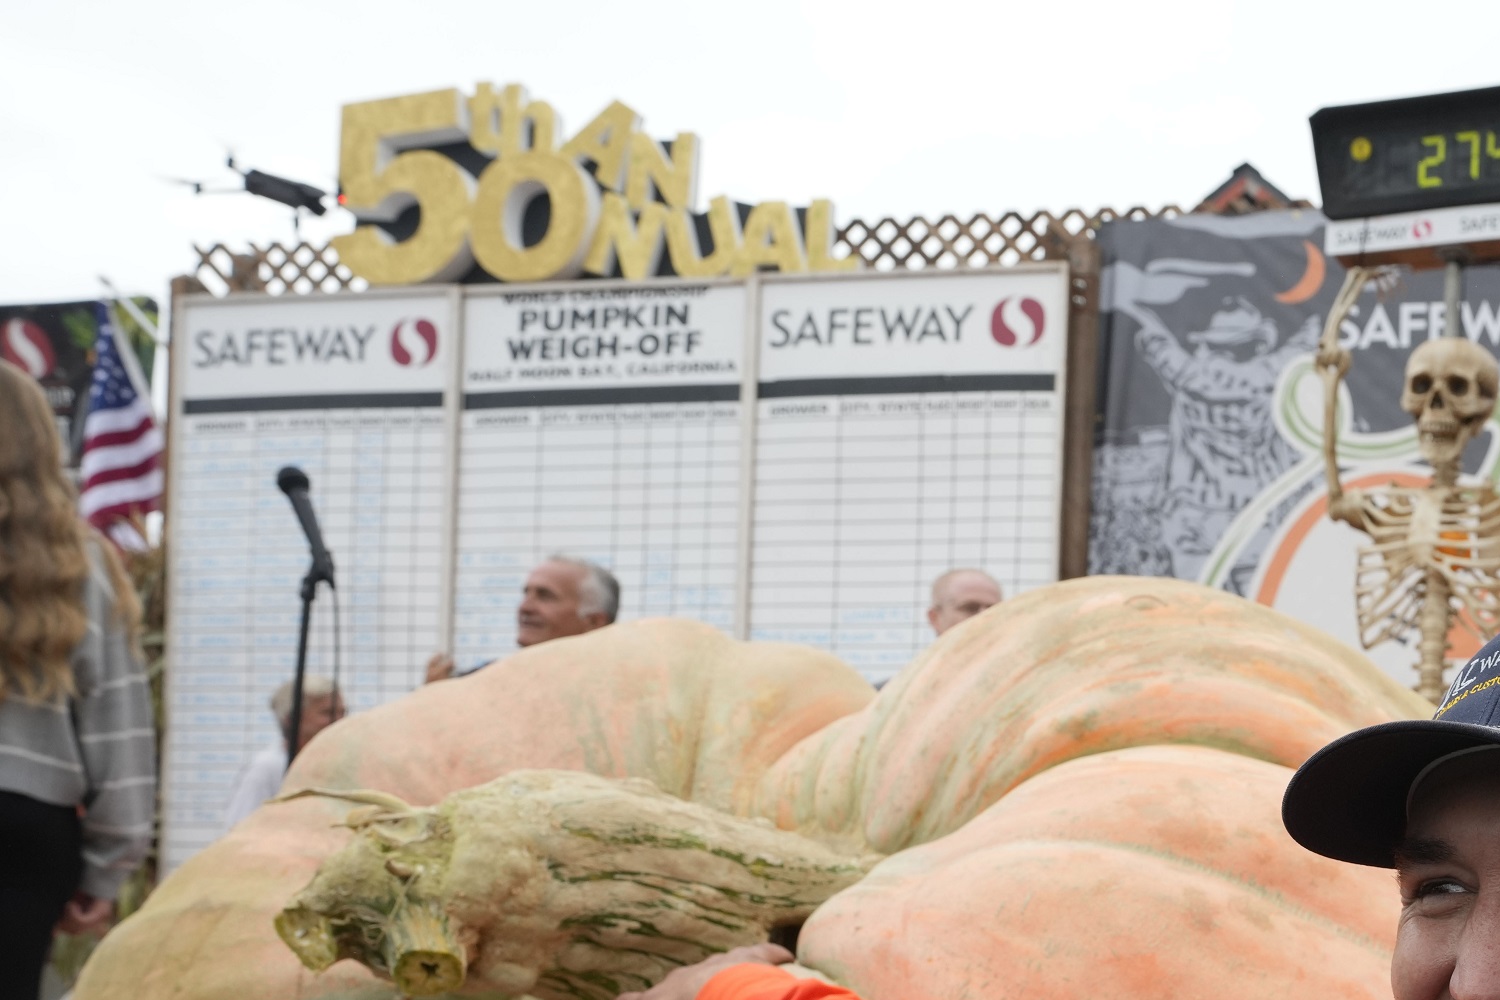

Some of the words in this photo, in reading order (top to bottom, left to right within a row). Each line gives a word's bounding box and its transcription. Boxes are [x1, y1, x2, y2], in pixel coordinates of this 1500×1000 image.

[1336, 227, 1409, 246] SAFEWAY
[518, 304, 691, 332] PUMPKIN
[768, 304, 974, 348] SAFEWAY
[193, 324, 376, 369] SAFEWAY
[508, 331, 702, 361] WEIGH-OFF
